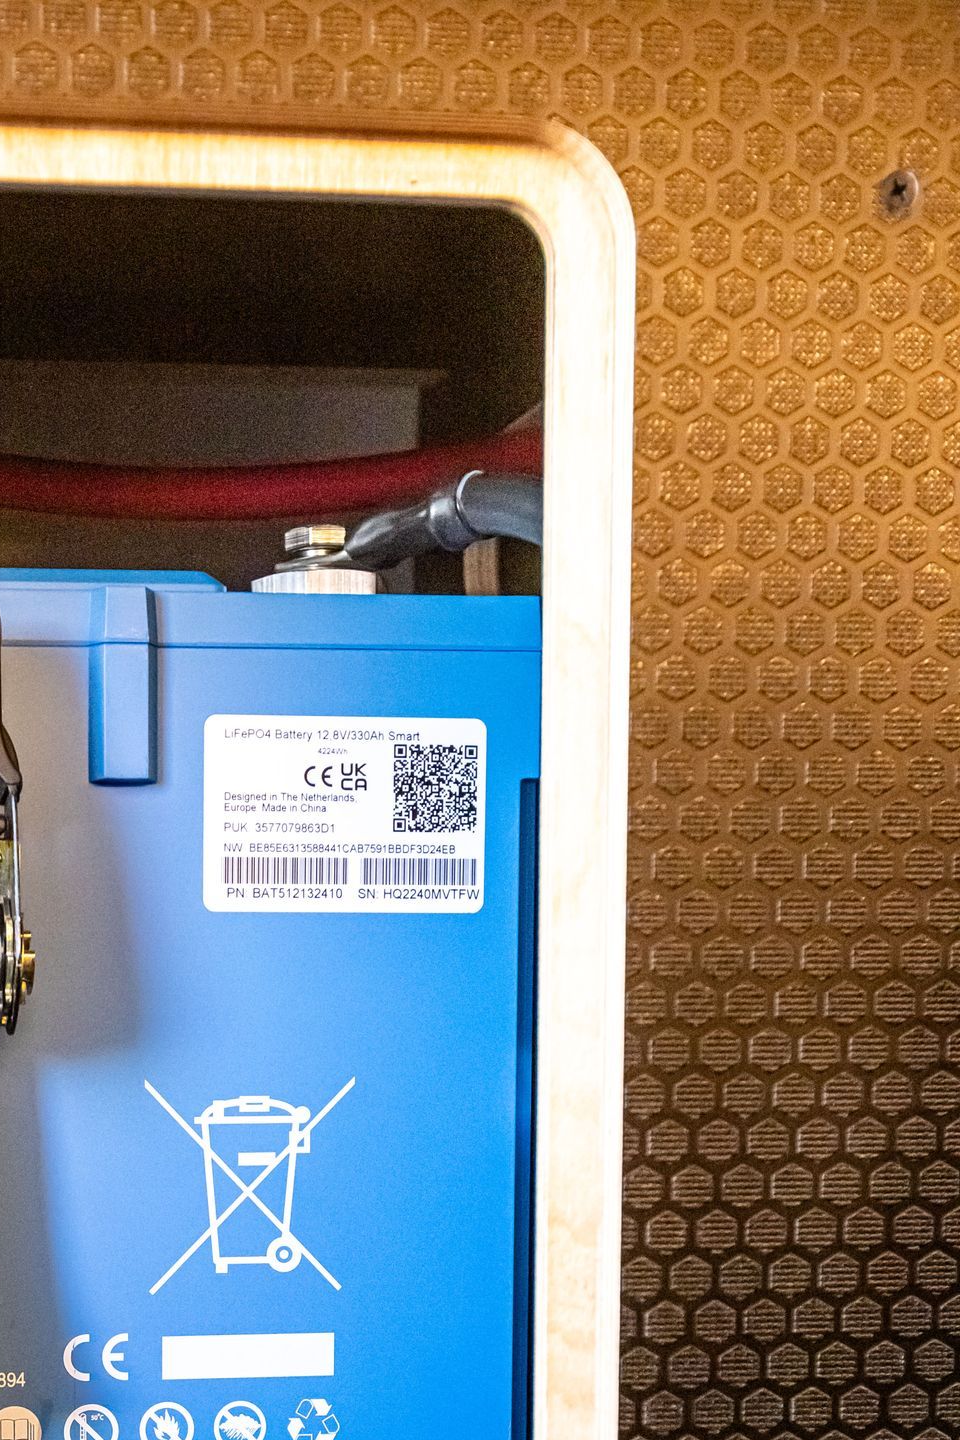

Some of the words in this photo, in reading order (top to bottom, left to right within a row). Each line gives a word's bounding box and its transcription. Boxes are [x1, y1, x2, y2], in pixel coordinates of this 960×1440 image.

[224, 729, 271, 739] LiFePO4
[275, 729, 313, 742] Battery
[389, 731, 420, 741] Smart
[224, 792, 266, 803] Designed
[281, 793, 298, 801] The
[262, 804, 287, 812] Made
[290, 804, 297, 812] in
[300, 804, 327, 813] China
[255, 823, 335, 833] 3577079863D1
[253, 889, 343, 899] BAT512132410
